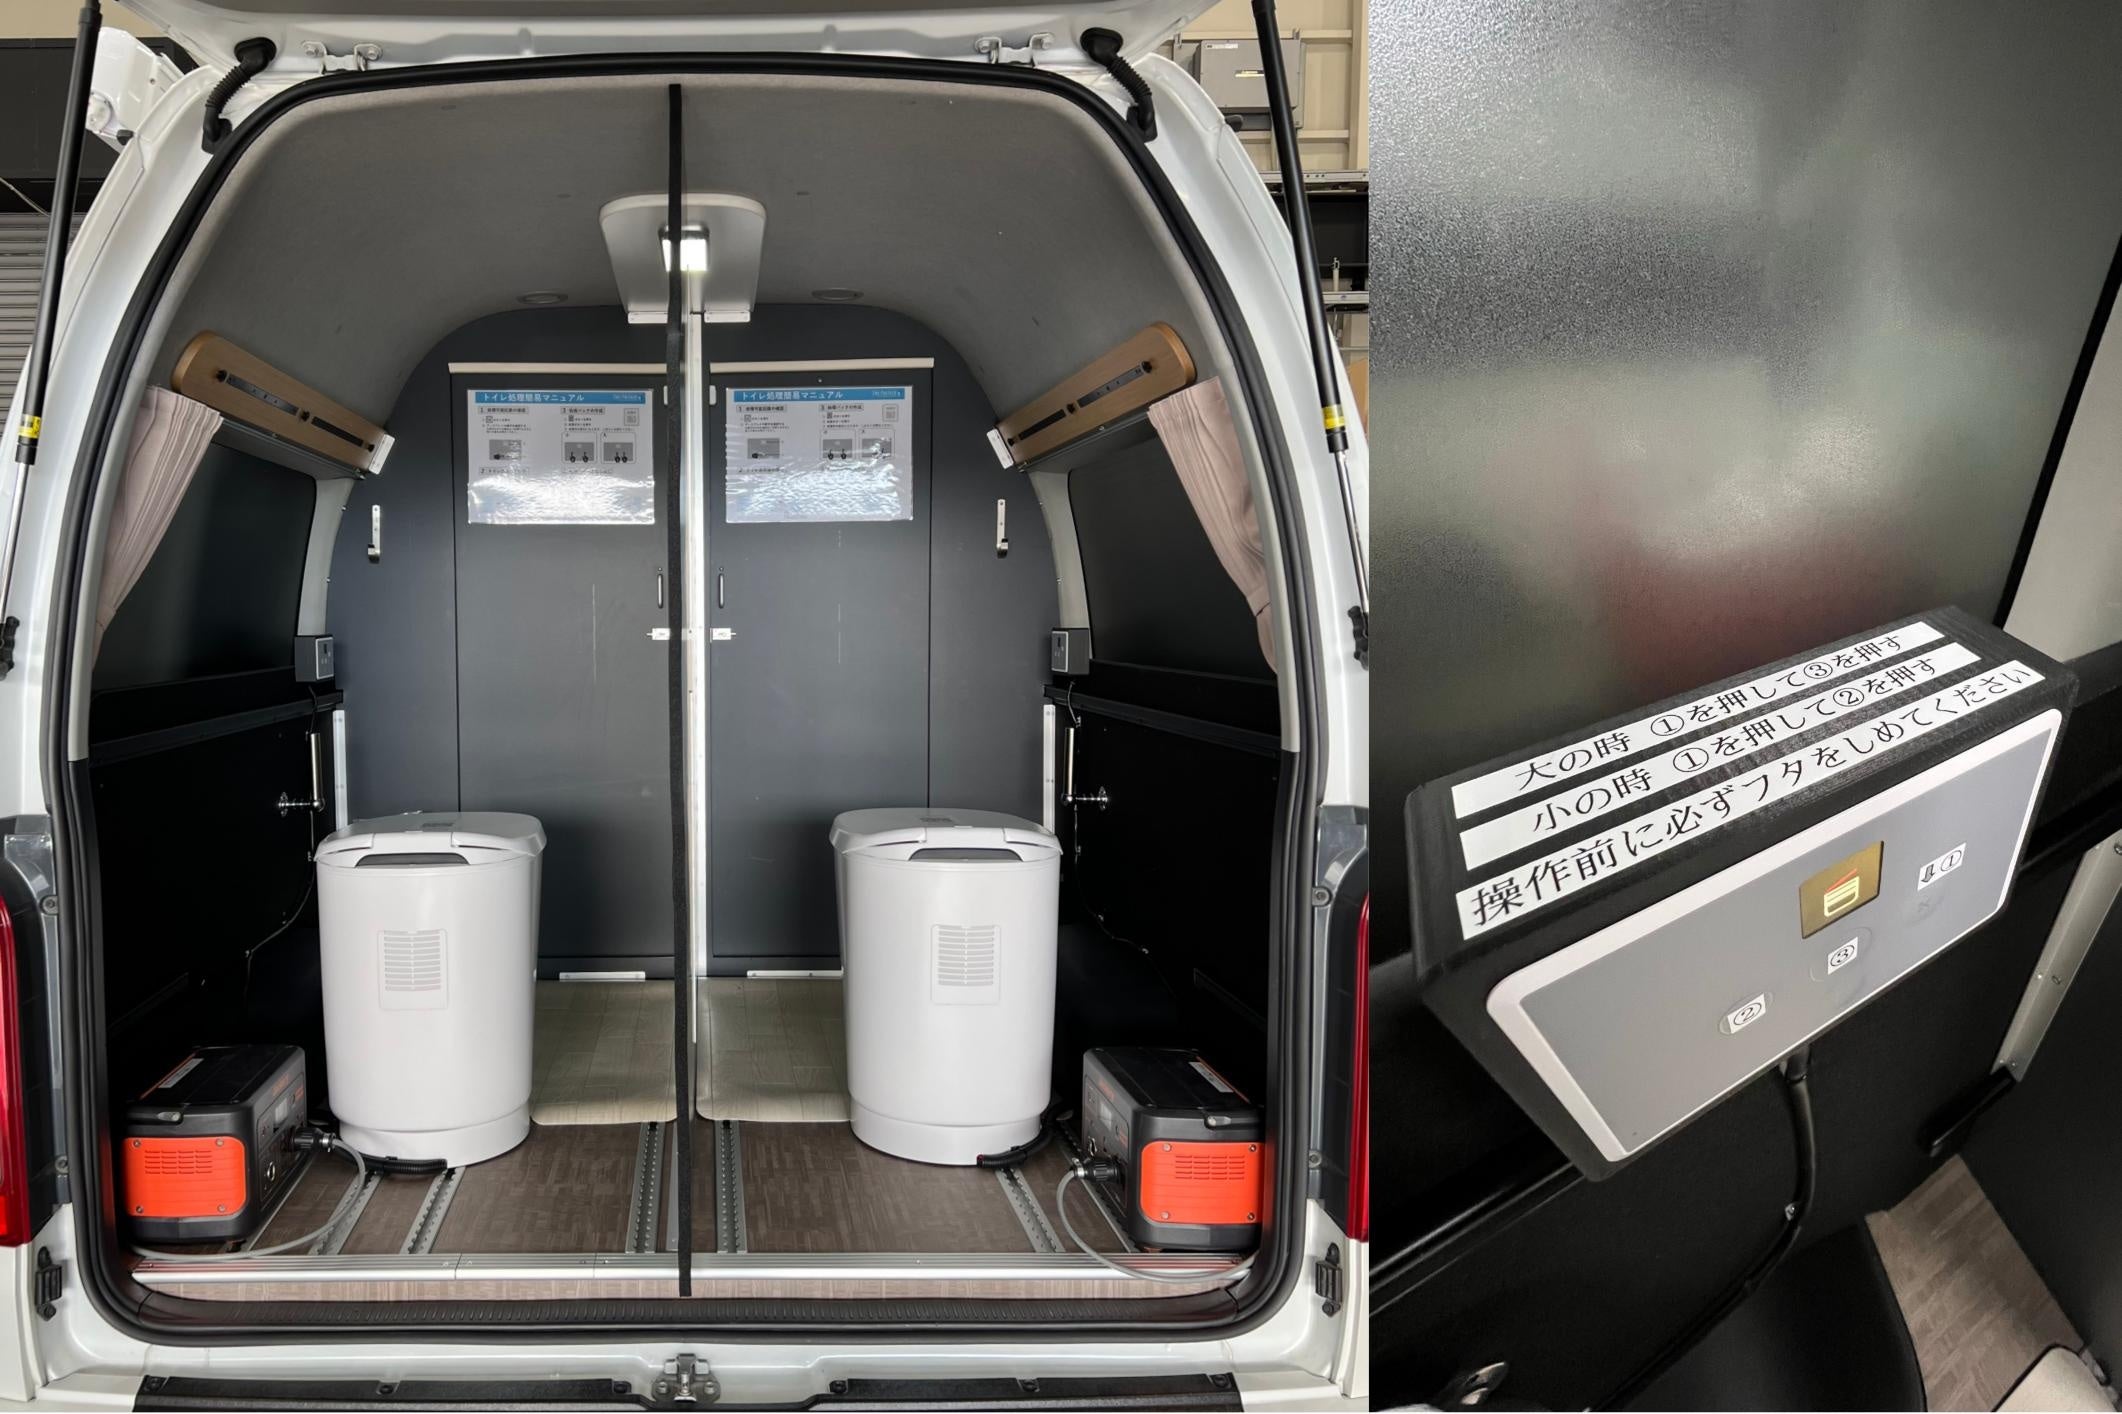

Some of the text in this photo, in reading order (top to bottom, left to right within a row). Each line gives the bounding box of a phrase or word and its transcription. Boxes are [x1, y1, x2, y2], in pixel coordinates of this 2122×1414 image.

[1514, 635, 1901, 791] 大の時 ①を押して③を押す
[1533, 658, 1936, 832] 小の時 ①を押して②を押す
[1471, 668, 2031, 926] 操作前に必ずフタをしめてください
[1733, 1002, 1762, 1026] ②
[1830, 944, 1855, 967] ③
